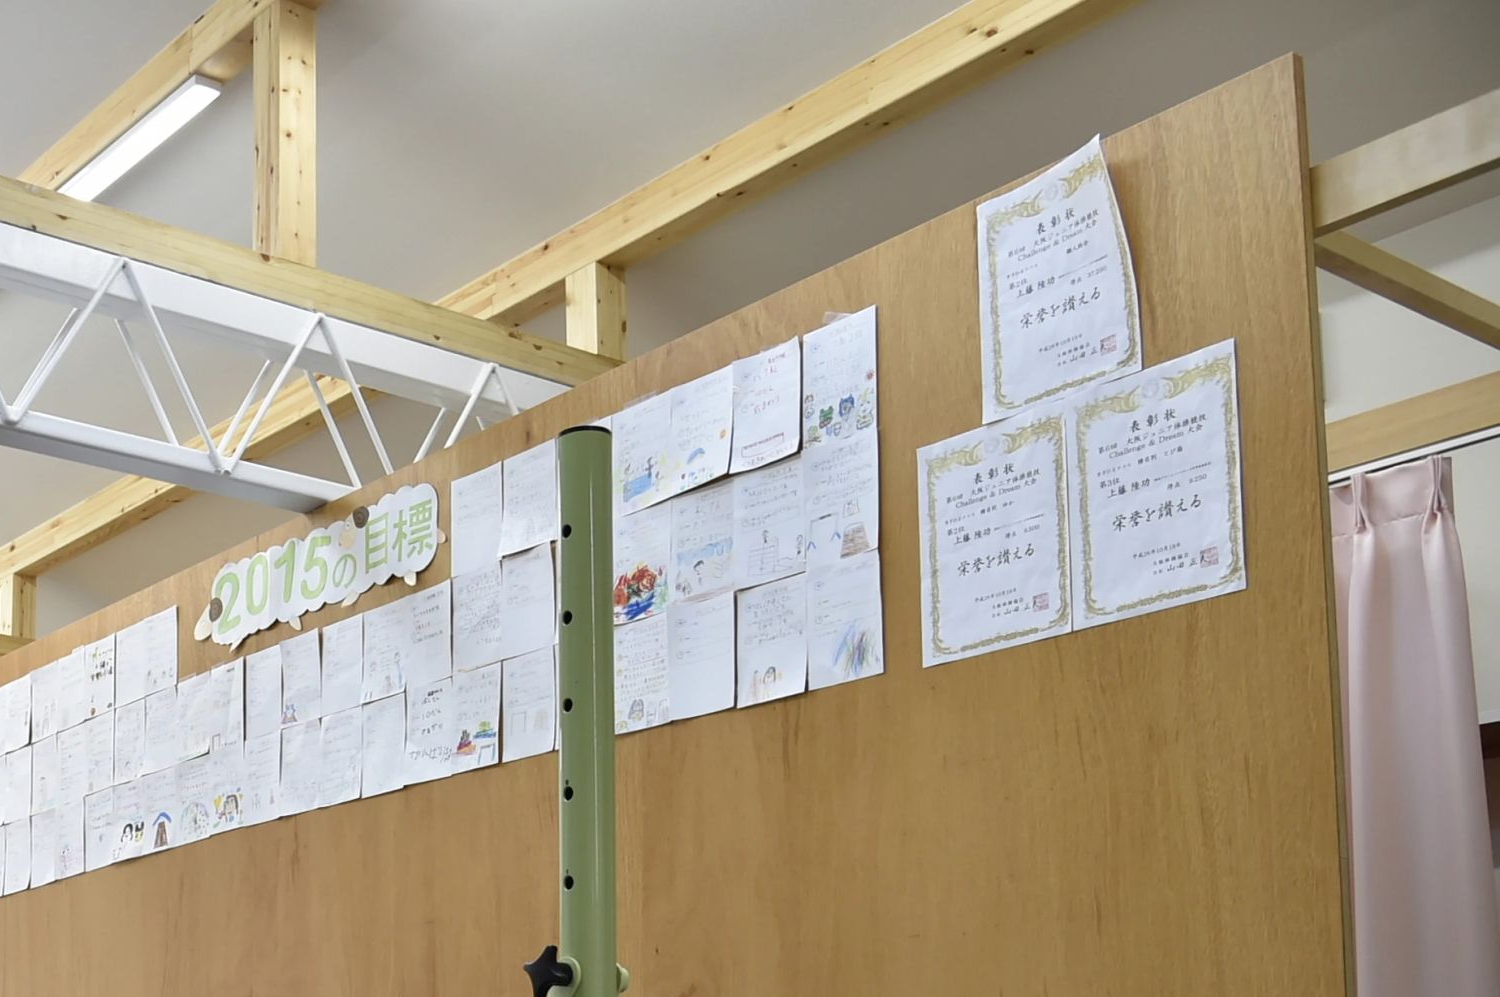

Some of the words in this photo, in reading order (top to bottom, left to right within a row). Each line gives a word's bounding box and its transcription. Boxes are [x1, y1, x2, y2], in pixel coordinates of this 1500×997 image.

[1131, 408, 1177, 432] 表彰状
[1109, 442, 1147, 459] Challenge
[1159, 431, 1184, 445] Dream
[974, 462, 1015, 485] 表彰状
[1112, 493, 1202, 533] 栄誉を讃える
[215, 499, 433, 635] 2015の目標
[958, 543, 1035, 577] 栄誉を讃える
